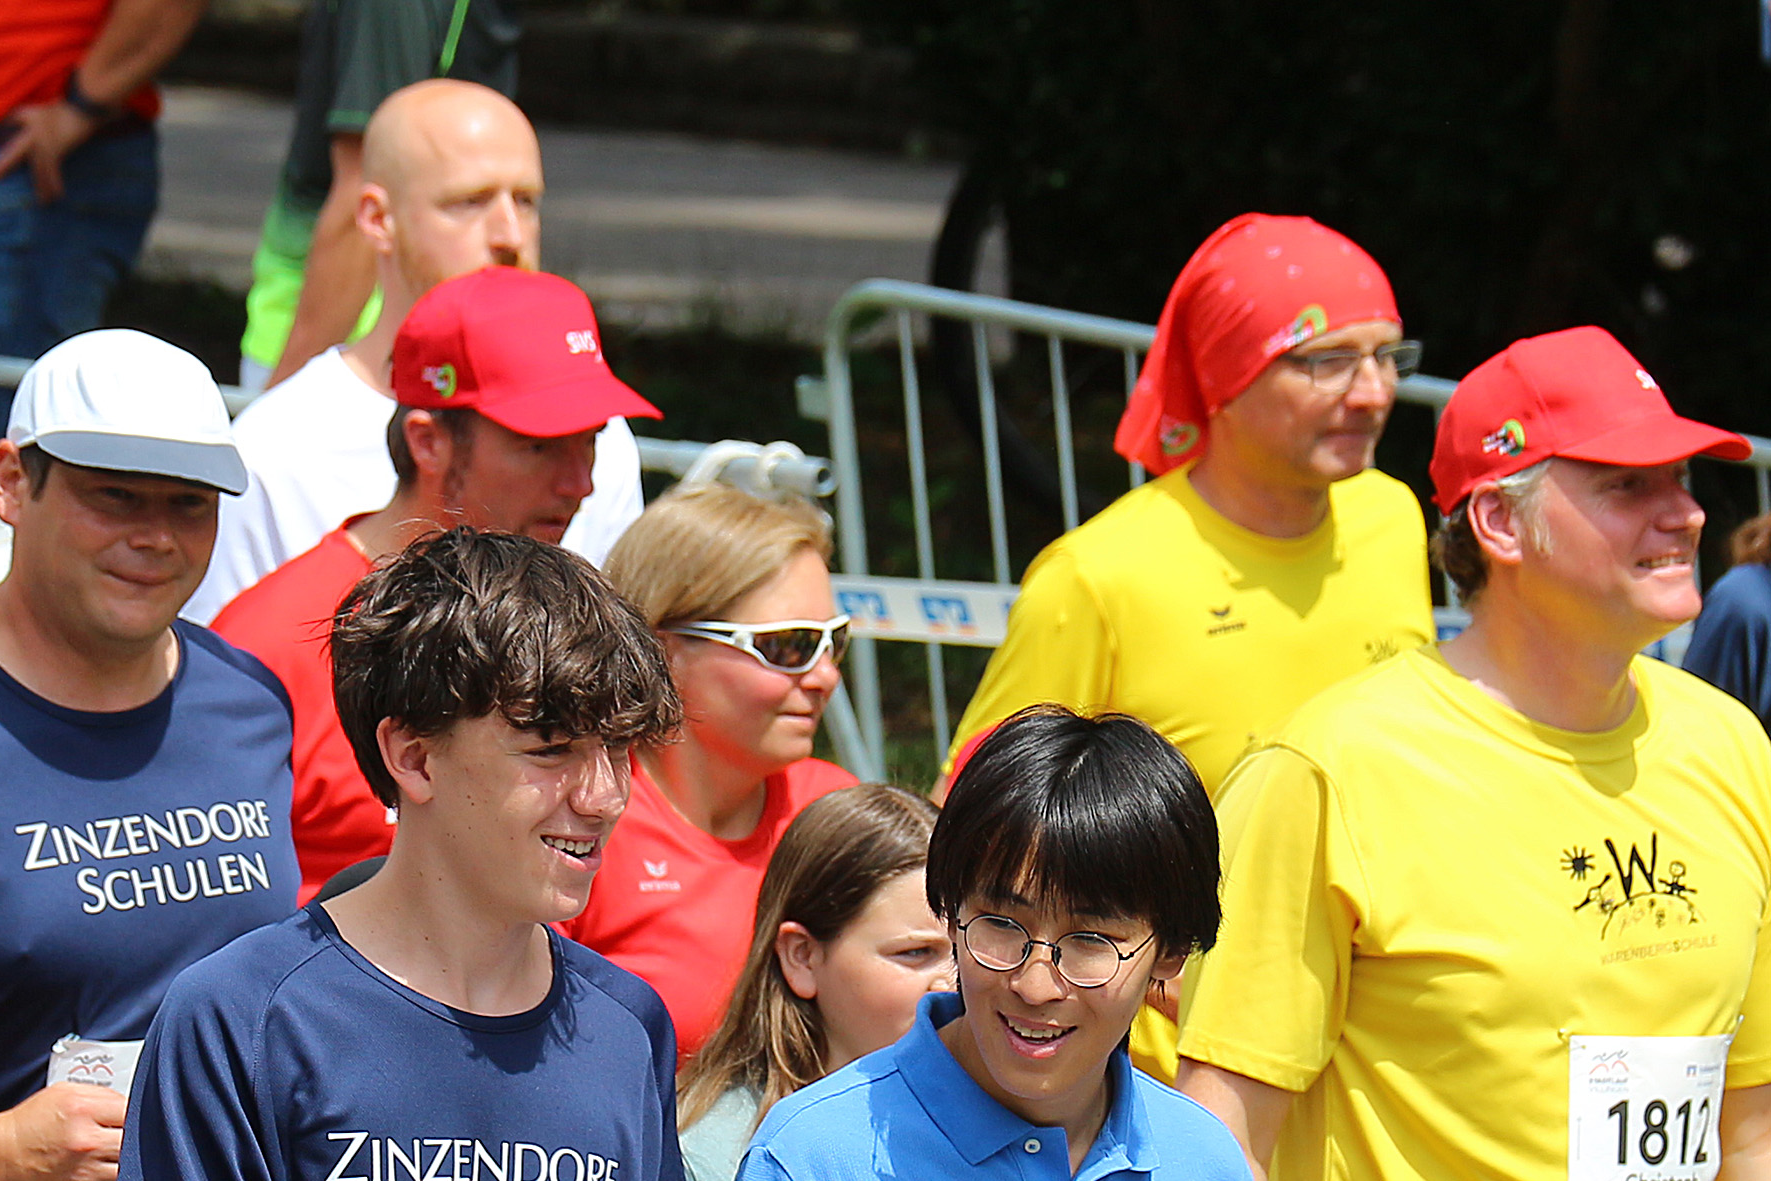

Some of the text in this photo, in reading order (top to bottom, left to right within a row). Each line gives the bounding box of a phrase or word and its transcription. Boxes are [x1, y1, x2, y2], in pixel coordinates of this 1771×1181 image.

[15, 800, 271, 871] ZINZENDORF
[77, 852, 271, 914] SCHULEN
[1607, 1097, 1710, 1167] 1812
